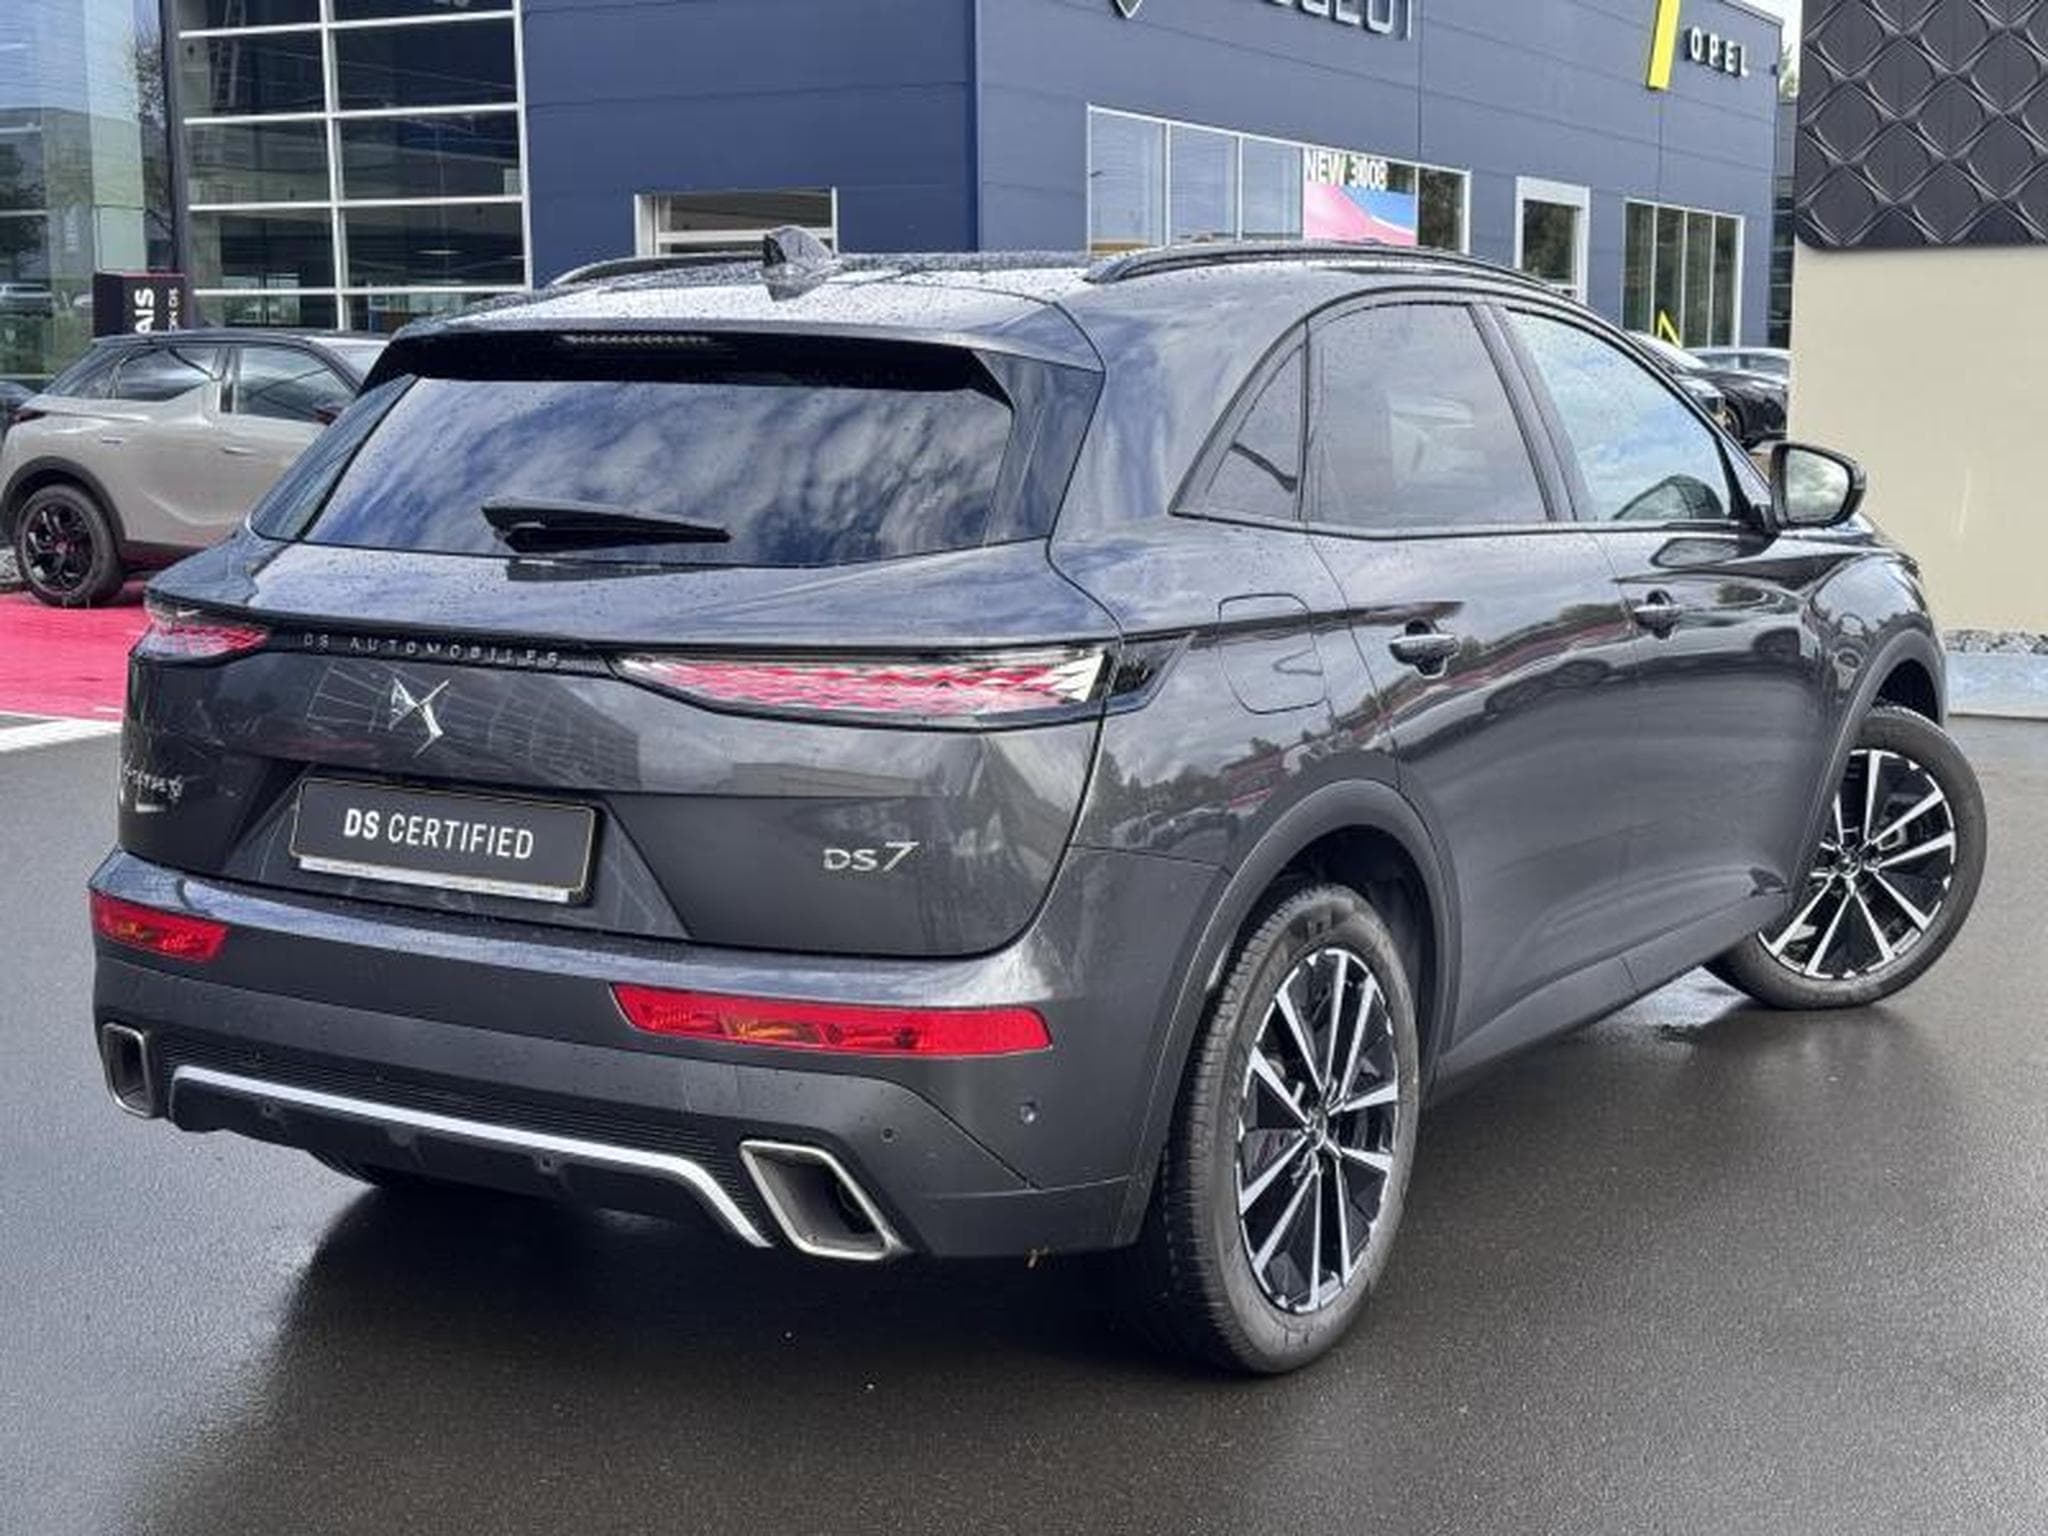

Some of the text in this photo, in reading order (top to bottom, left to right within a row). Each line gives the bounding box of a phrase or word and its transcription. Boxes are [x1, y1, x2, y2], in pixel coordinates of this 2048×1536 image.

[1689, 25, 1750, 78] OPEL
[1303, 147, 1388, 191] NEW 3008
[303, 633, 559, 667] DS AUTOMOBILES
[344, 808, 534, 860] DS CERTIFIED
